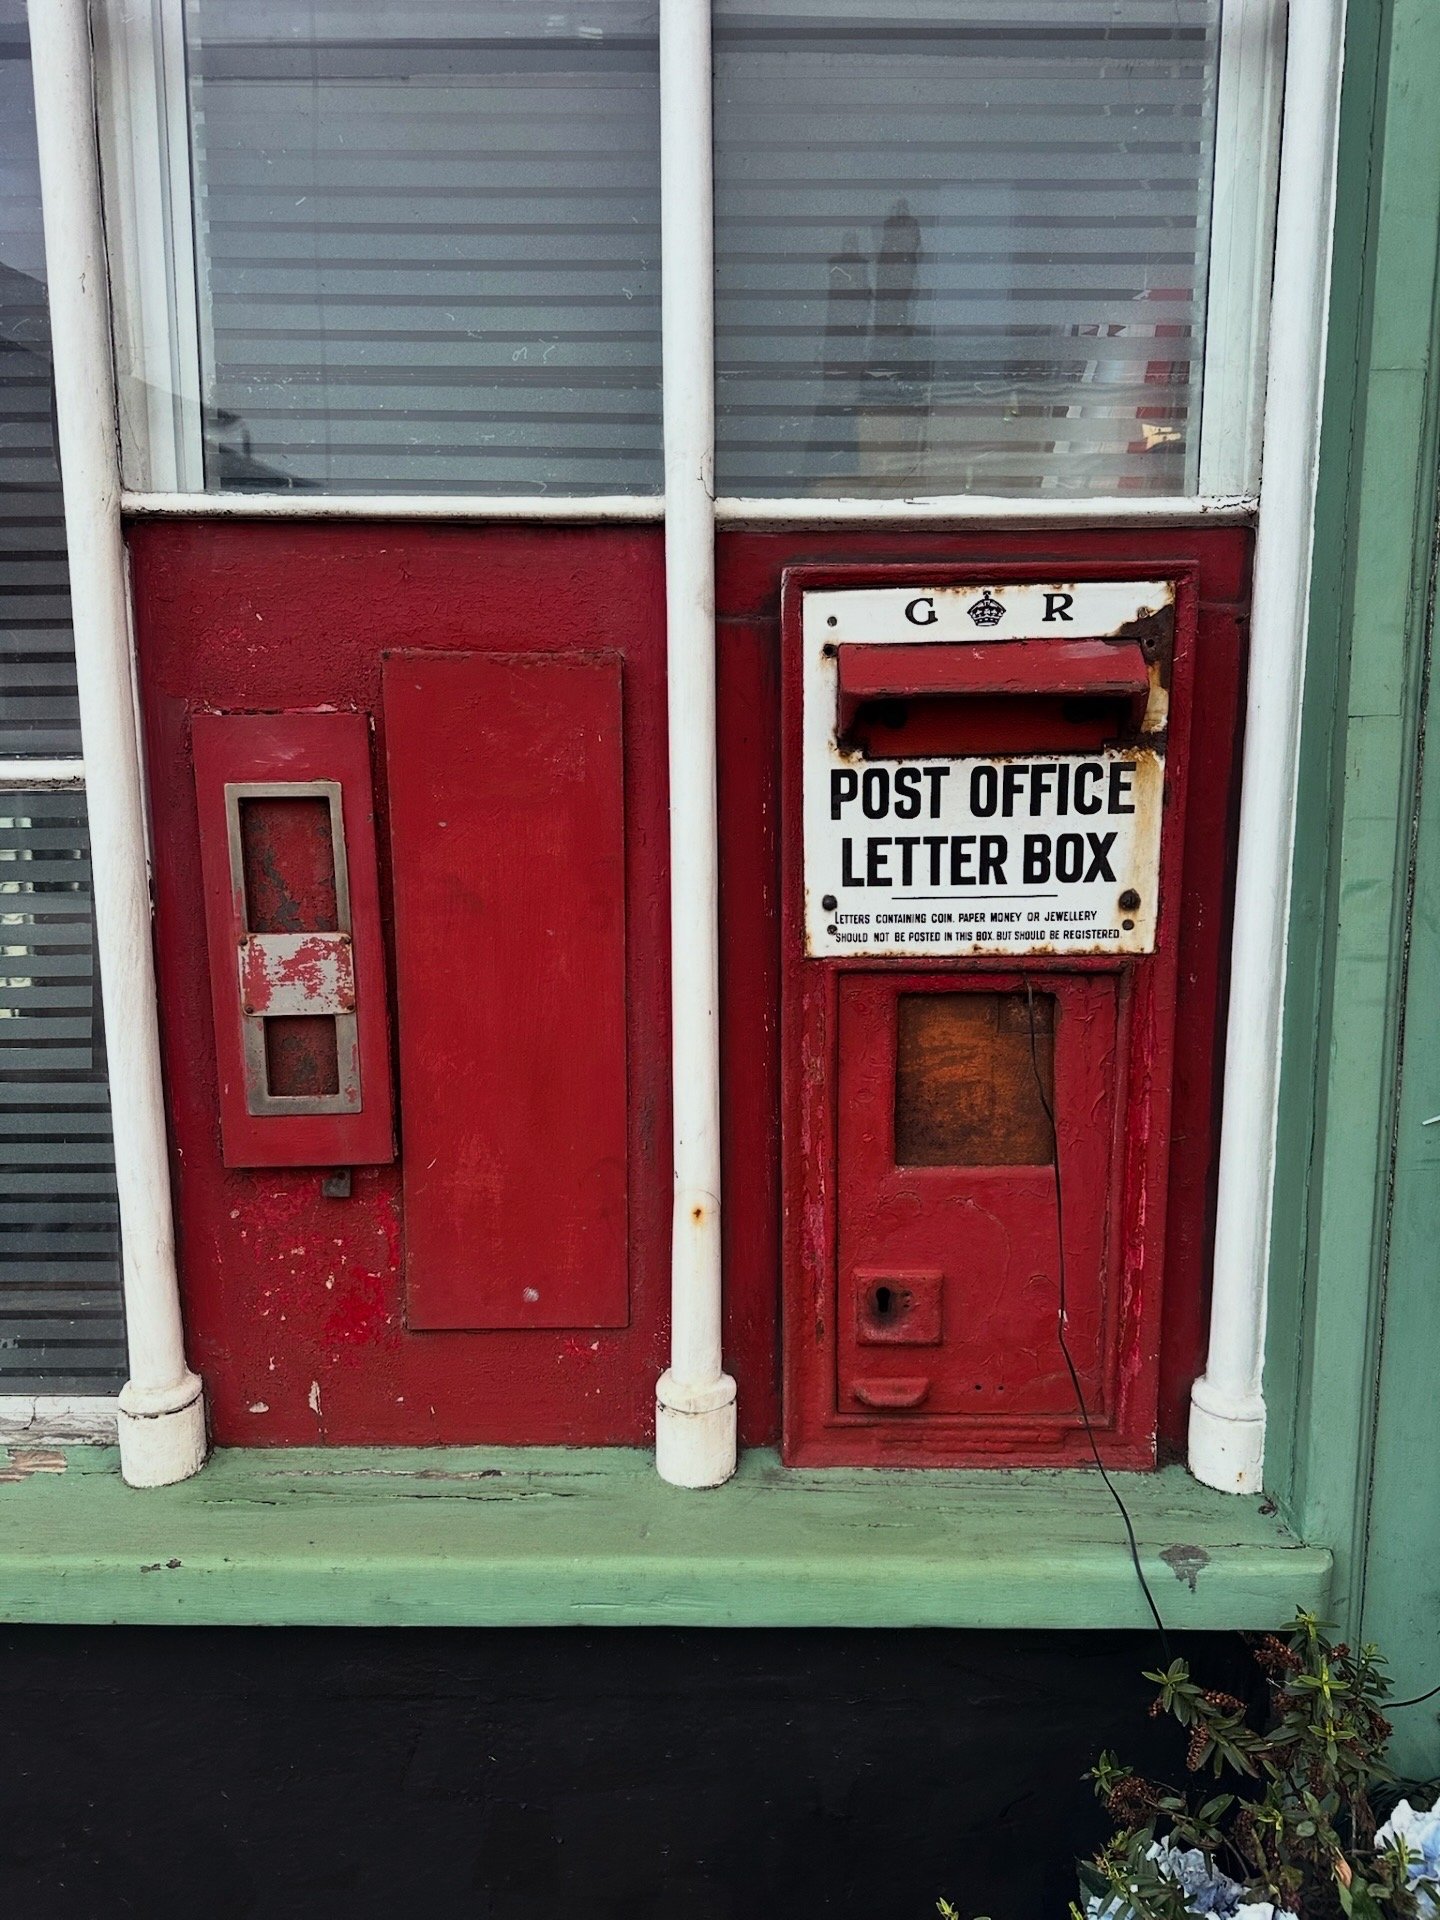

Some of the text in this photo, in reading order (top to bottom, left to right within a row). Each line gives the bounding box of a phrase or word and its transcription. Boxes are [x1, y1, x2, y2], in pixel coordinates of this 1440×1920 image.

[904, 593, 1074, 626] G R
[830, 762, 1137, 821] POST OFFICE
[841, 831, 1118, 888] LETTER BOX
[834, 911, 871, 925] LETTERS
[875, 913, 927, 925] CONTAINING
[958, 912, 986, 923] PAPER
[990, 911, 1022, 923] MONEY
[1026, 911, 1040, 922] OR
[1044, 910, 1098, 922] JEWELLERY
[835, 932, 869, 943] SHOULD
[873, 931, 890, 943] NOT
[894, 931, 906, 943] BE
[908, 931, 941, 942] POSTED
[944, 931, 953, 942] IN
[955, 931, 973, 942] THIS
[996, 930, 1012, 941] BUT
[1014, 929, 1046, 941] SHOULD
[1049, 929, 1060, 940] BE
